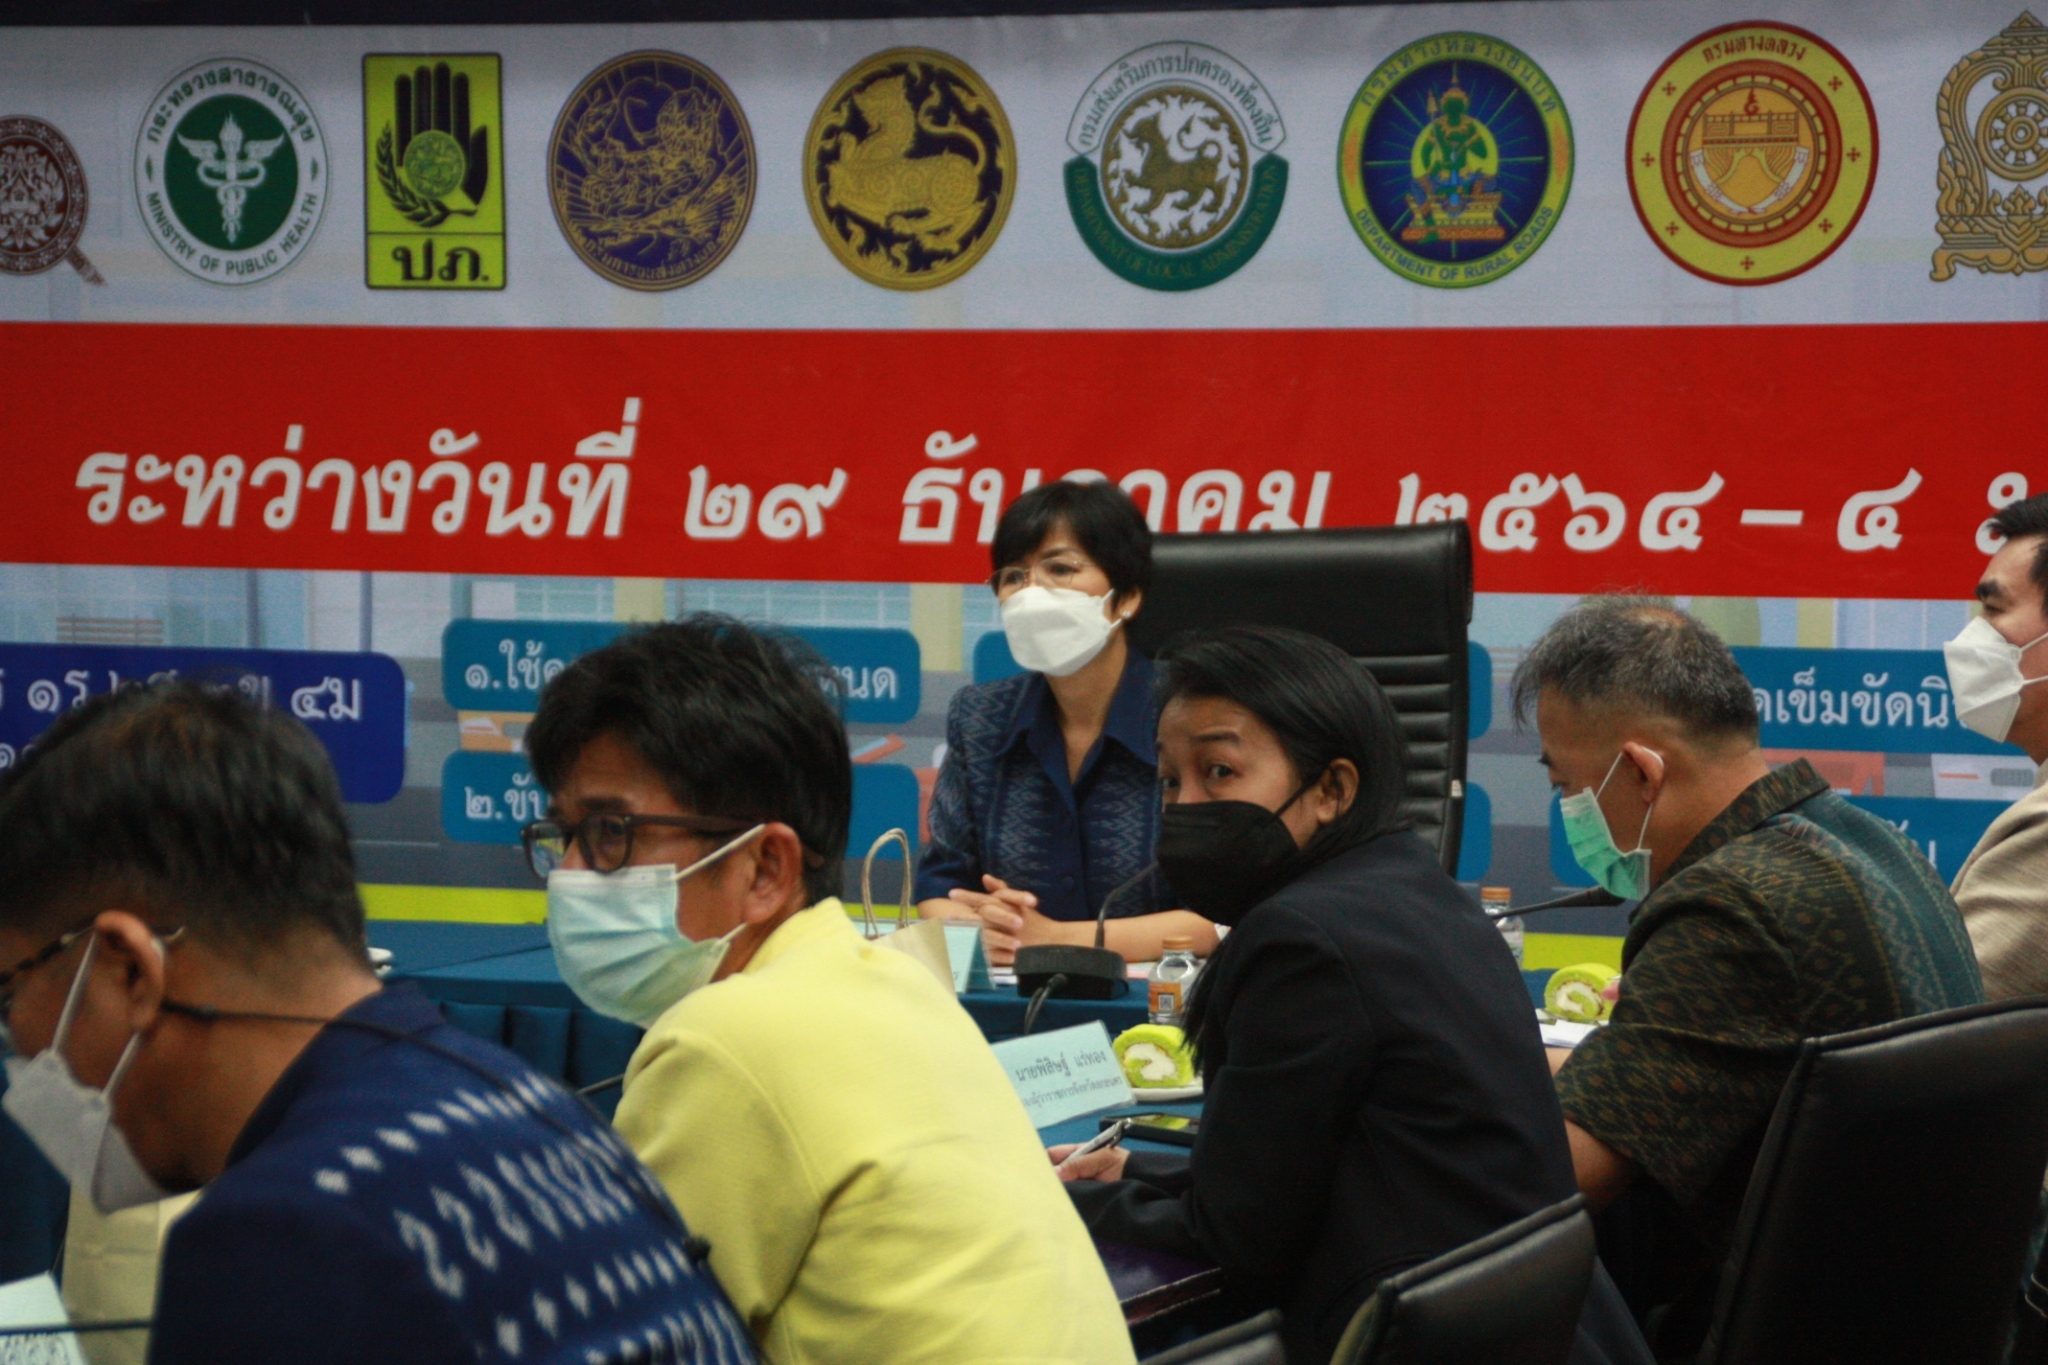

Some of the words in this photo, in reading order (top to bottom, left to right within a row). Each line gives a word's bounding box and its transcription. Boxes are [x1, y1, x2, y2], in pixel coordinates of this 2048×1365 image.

[147, 191, 196, 260] MINISTRY
[199, 254, 220, 272] OF
[225, 249, 278, 275] PUBLIC
[280, 192, 317, 255] HEALTH
[391, 237, 490, 282] ปภ.
[1355, 208, 1436, 278] DEPARTMENT
[1439, 267, 1459, 280] OF
[1464, 254, 1513, 279] RURAL
[1513, 206, 1553, 255] ROADS
[75, 396, 641, 538] ระหว่างวันที่
[683, 464, 847, 541] ๒๙
[1836, 467, 1923, 552] ๔
[291, 675, 361, 720] ๔ม
